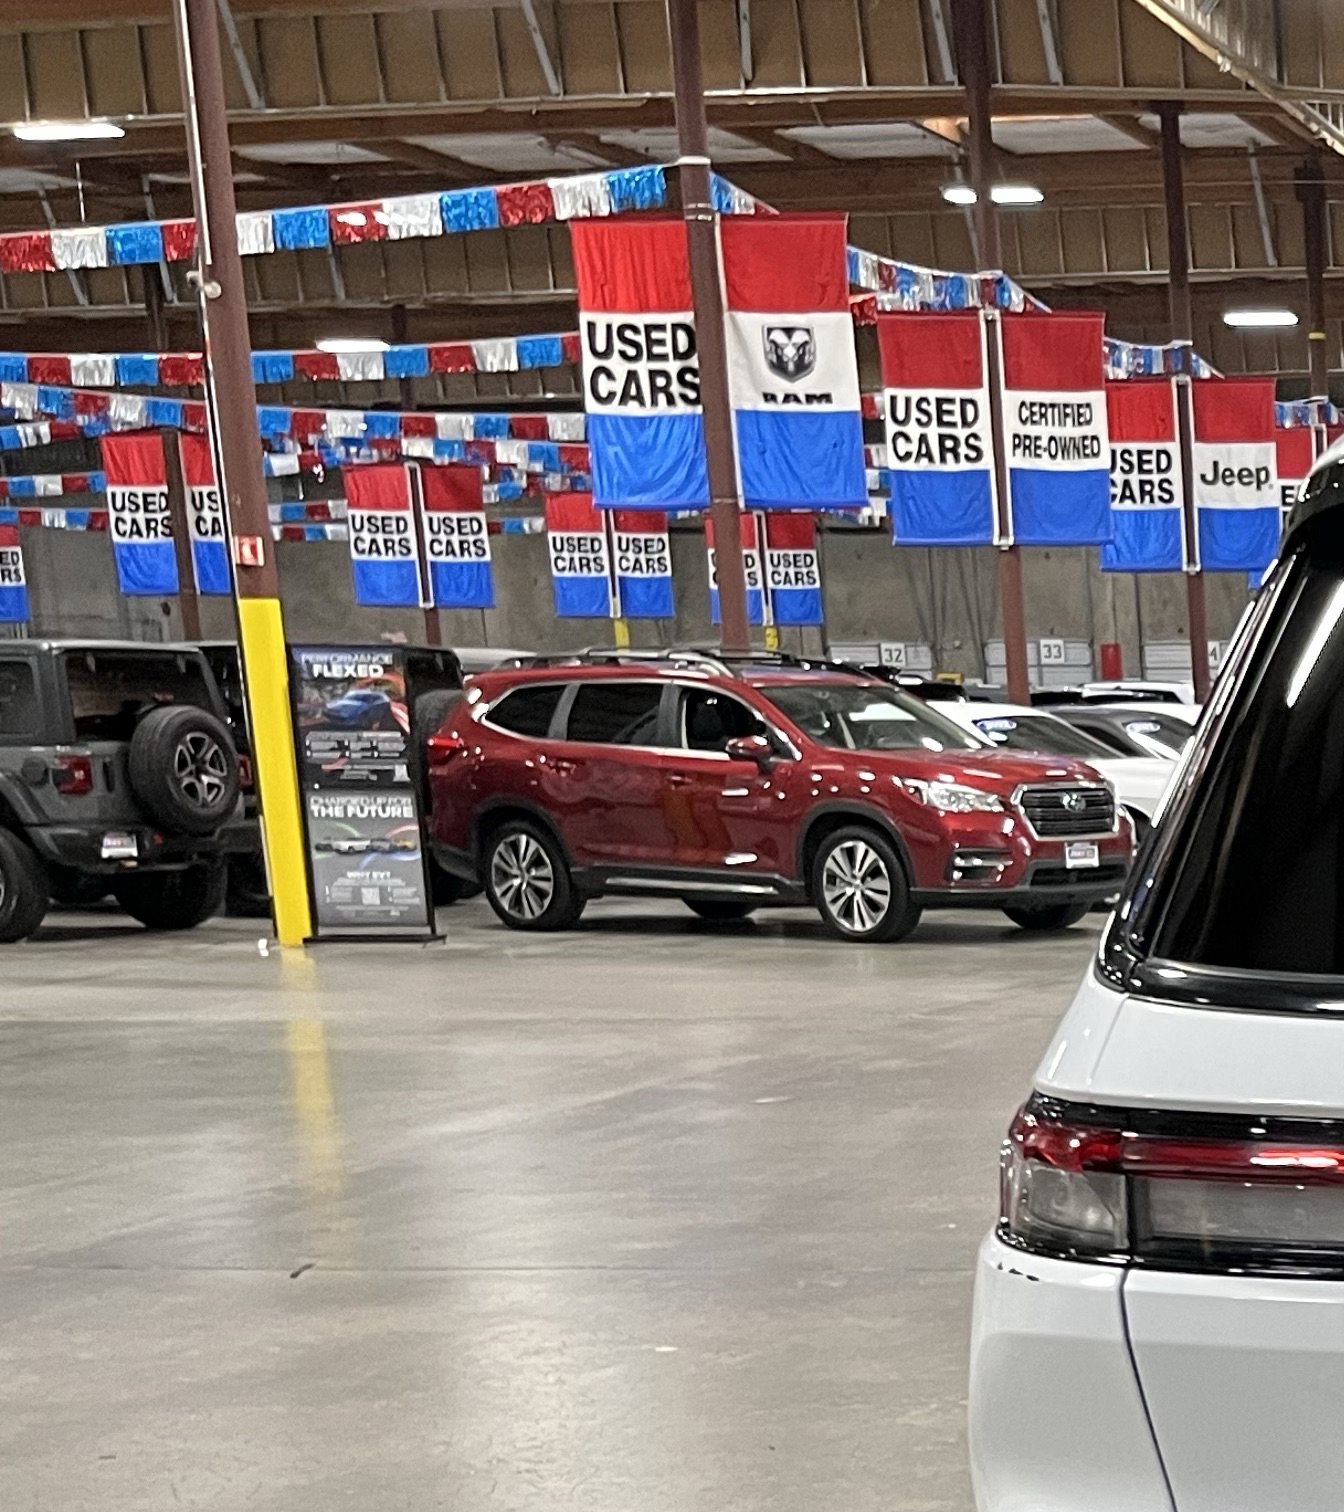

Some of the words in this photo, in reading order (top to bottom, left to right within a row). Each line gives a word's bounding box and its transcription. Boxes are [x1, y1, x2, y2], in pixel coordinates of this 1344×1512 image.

[587, 321, 698, 363] USED
[590, 366, 700, 408] CARS
[762, 392, 833, 404] RAM
[890, 395, 979, 429] USED
[1018, 400, 1093, 427] CERTIFIED
[892, 430, 984, 464] CARS
[1012, 433, 1101, 460] PRE-OWNED
[1200, 460, 1270, 491] Jeep
[111, 491, 168, 513] USED
[191, 491, 219, 512] US
[114, 516, 172, 538] CARS
[195, 516, 223, 537] CA
[351, 514, 408, 534] USED
[428, 516, 483, 536] USED
[353, 536, 412, 556] CARS
[429, 538, 487, 557] CARS
[552, 536, 602, 553] USED
[617, 536, 665, 554] USED
[0, 551, 19, 566] ED
[554, 556, 605, 573] CARS
[618, 556, 668, 574] CARS
[769, 553, 814, 568] USED
[0, 568, 22, 582] RS
[771, 570, 817, 585] CARS
[884, 647, 902, 662] 32
[1043, 644, 1063, 660] 33
[313, 664, 384, 678] FLEXED
[311, 806, 344, 818] THE
[347, 806, 413, 818] FUTURE
